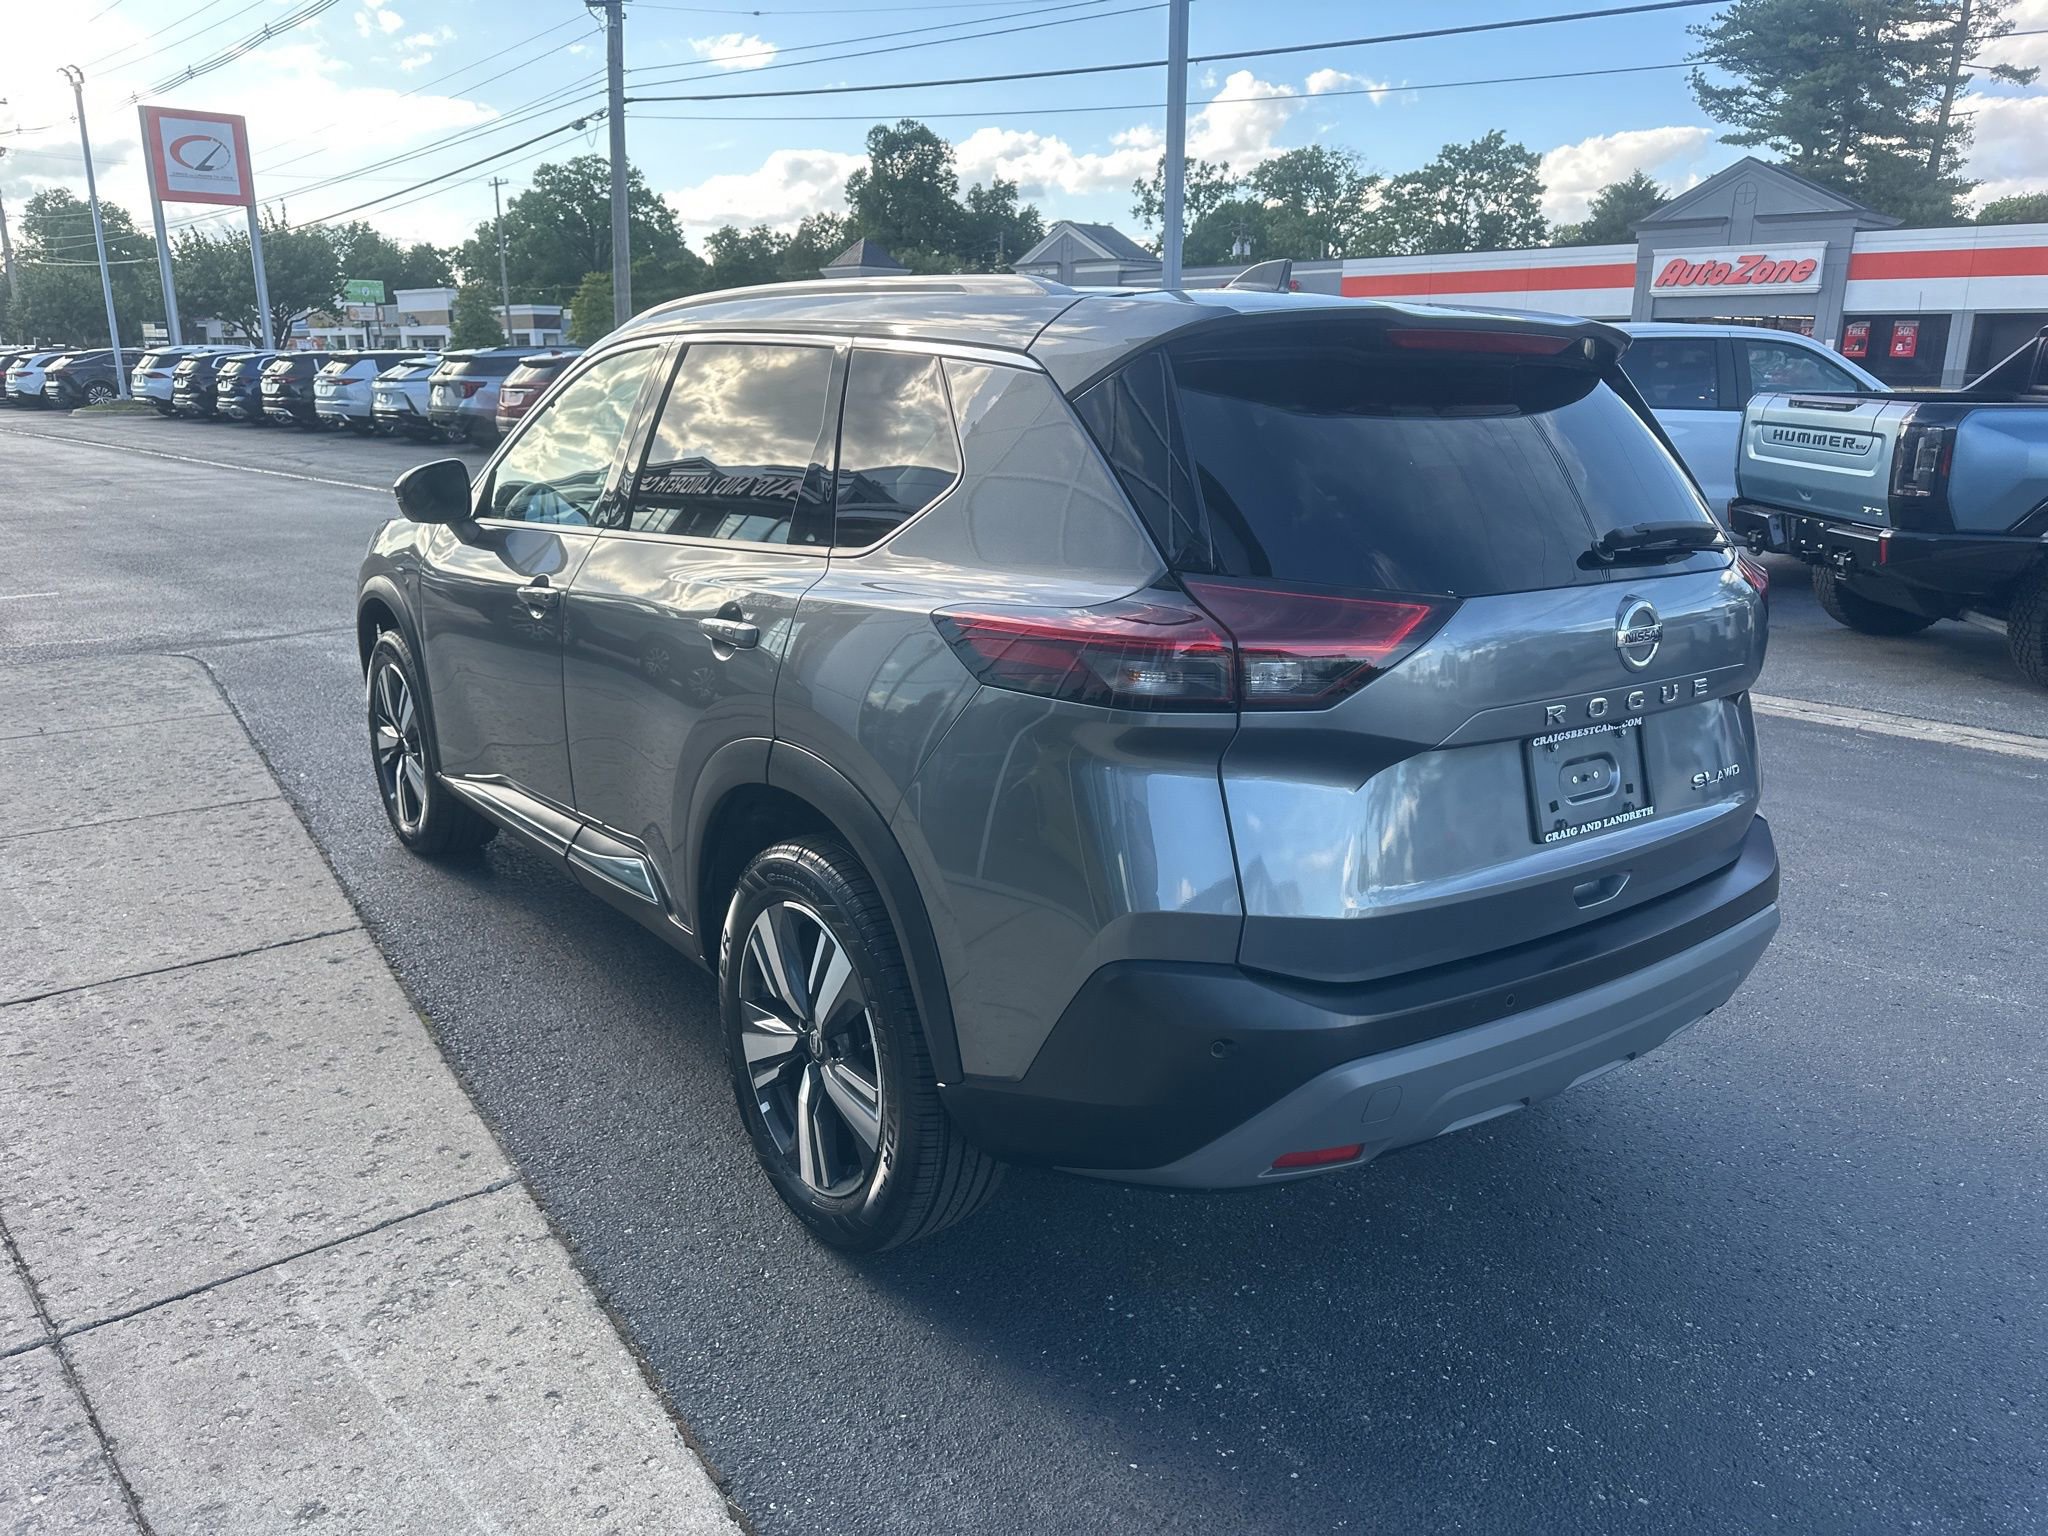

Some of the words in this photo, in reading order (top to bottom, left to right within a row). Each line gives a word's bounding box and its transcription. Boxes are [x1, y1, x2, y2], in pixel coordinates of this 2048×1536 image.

[1654, 254, 1818, 287] AutoZone
[1847, 326, 1867, 336] FREE
[1772, 428, 1856, 449] HUMMER
[1624, 628, 1662, 644] NISSAN
[1545, 677, 1708, 726] ROGUE
[1692, 770, 1718, 789] SL
[1716, 763, 1740, 784] AWD
[1545, 826, 1578, 843] CRAIG
[1579, 819, 1602, 835] AND
[1602, 805, 1654, 829] LANDRETH
